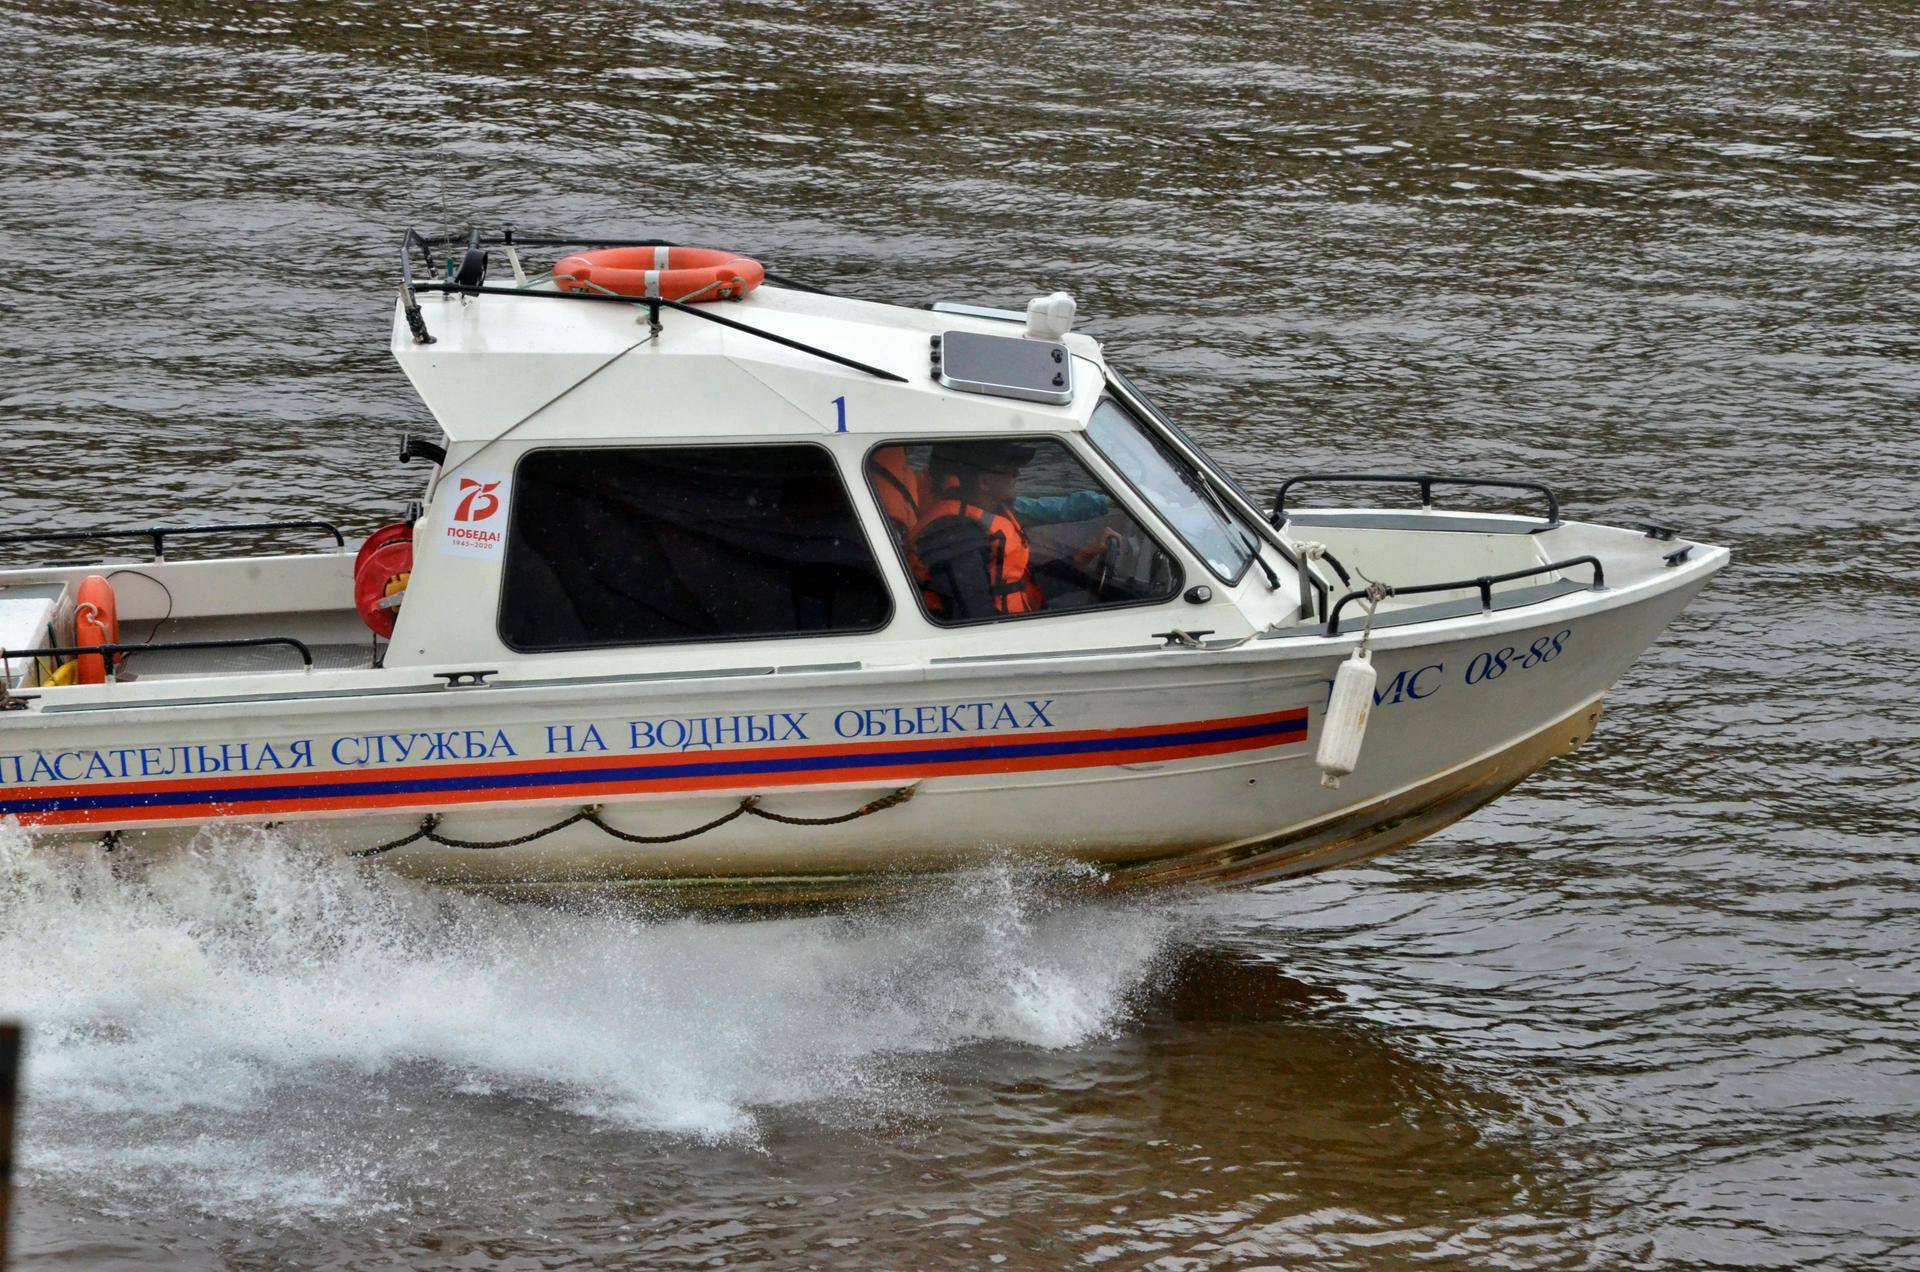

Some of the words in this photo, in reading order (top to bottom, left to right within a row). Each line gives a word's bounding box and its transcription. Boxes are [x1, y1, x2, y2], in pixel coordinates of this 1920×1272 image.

[831, 395, 850, 433] 1
[453, 478, 502, 522] 75
[447, 527, 501, 542] ПОБЕДА!
[452, 539, 493, 550] 1945-2020
[1465, 629, 1571, 685] 08-88
[0, 739, 315, 784] ПАСАТЕЛЬНАЯ
[331, 729, 519, 768] СЛУЖБА
[544, 724, 609, 754] НА
[629, 712, 810, 752] ВОДНЫХ
[834, 699, 1055, 739] ОБЪЕКТАХ
